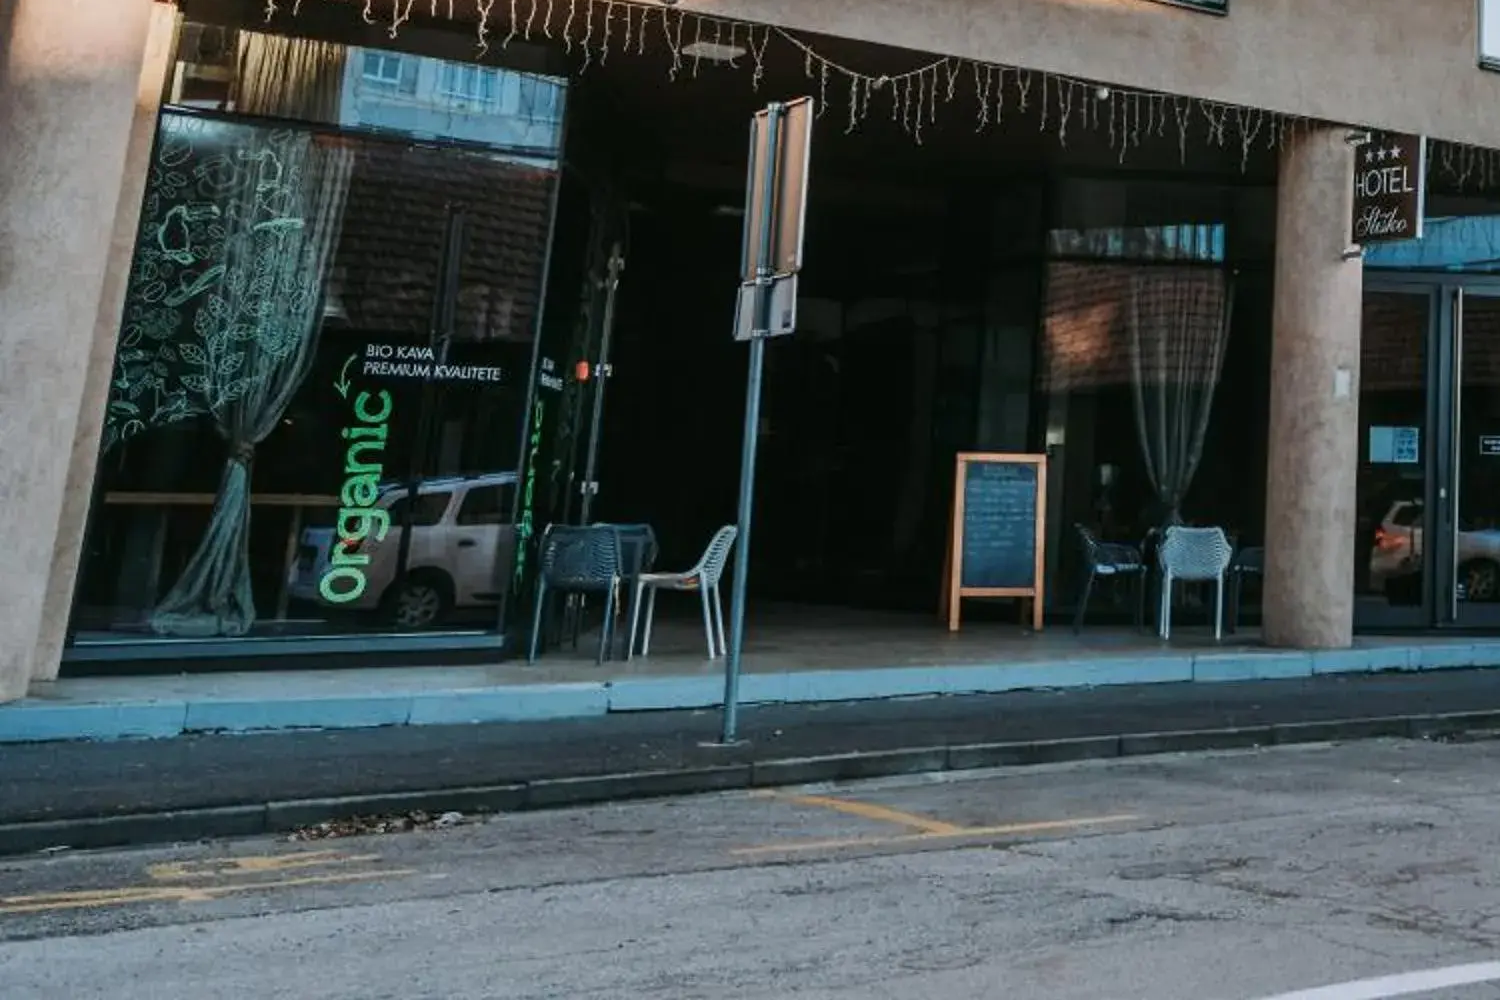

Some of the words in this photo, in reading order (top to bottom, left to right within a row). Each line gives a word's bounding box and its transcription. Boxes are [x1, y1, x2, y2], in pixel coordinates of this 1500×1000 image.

[1355, 165, 1416, 197] HOTEL
[365, 344, 393, 358] BIO
[396, 345, 435, 361] KAVA
[363, 361, 431, 377] PREMIUM
[433, 364, 502, 381] KVALITETE
